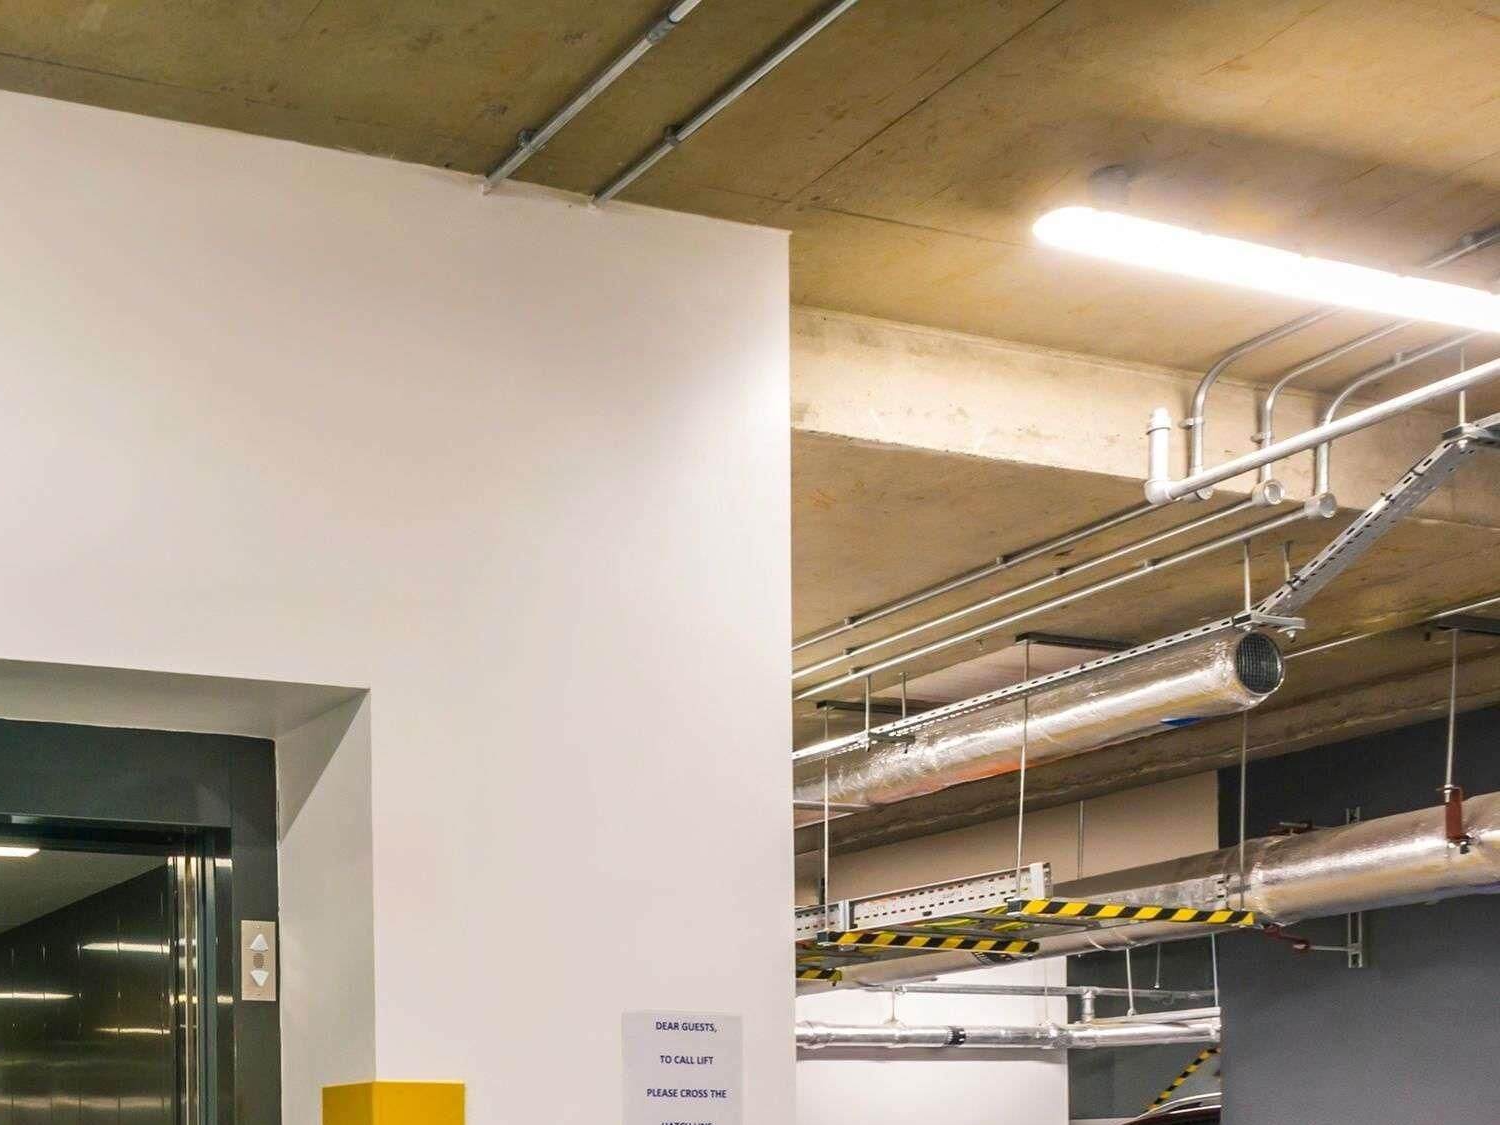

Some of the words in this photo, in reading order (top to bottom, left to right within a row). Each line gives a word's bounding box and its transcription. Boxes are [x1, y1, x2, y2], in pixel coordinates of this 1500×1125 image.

[655, 1021, 679, 1031] DEAR
[681, 1022, 718, 1033] GUESTS,
[660, 1055, 672, 1064] TO
[674, 1055, 694, 1065] CALL
[697, 1056, 713, 1065] LIFT
[646, 1088, 678, 1098] PLEASE
[680, 1089, 708, 1099] CROSS
[710, 1090, 727, 1099] THE
